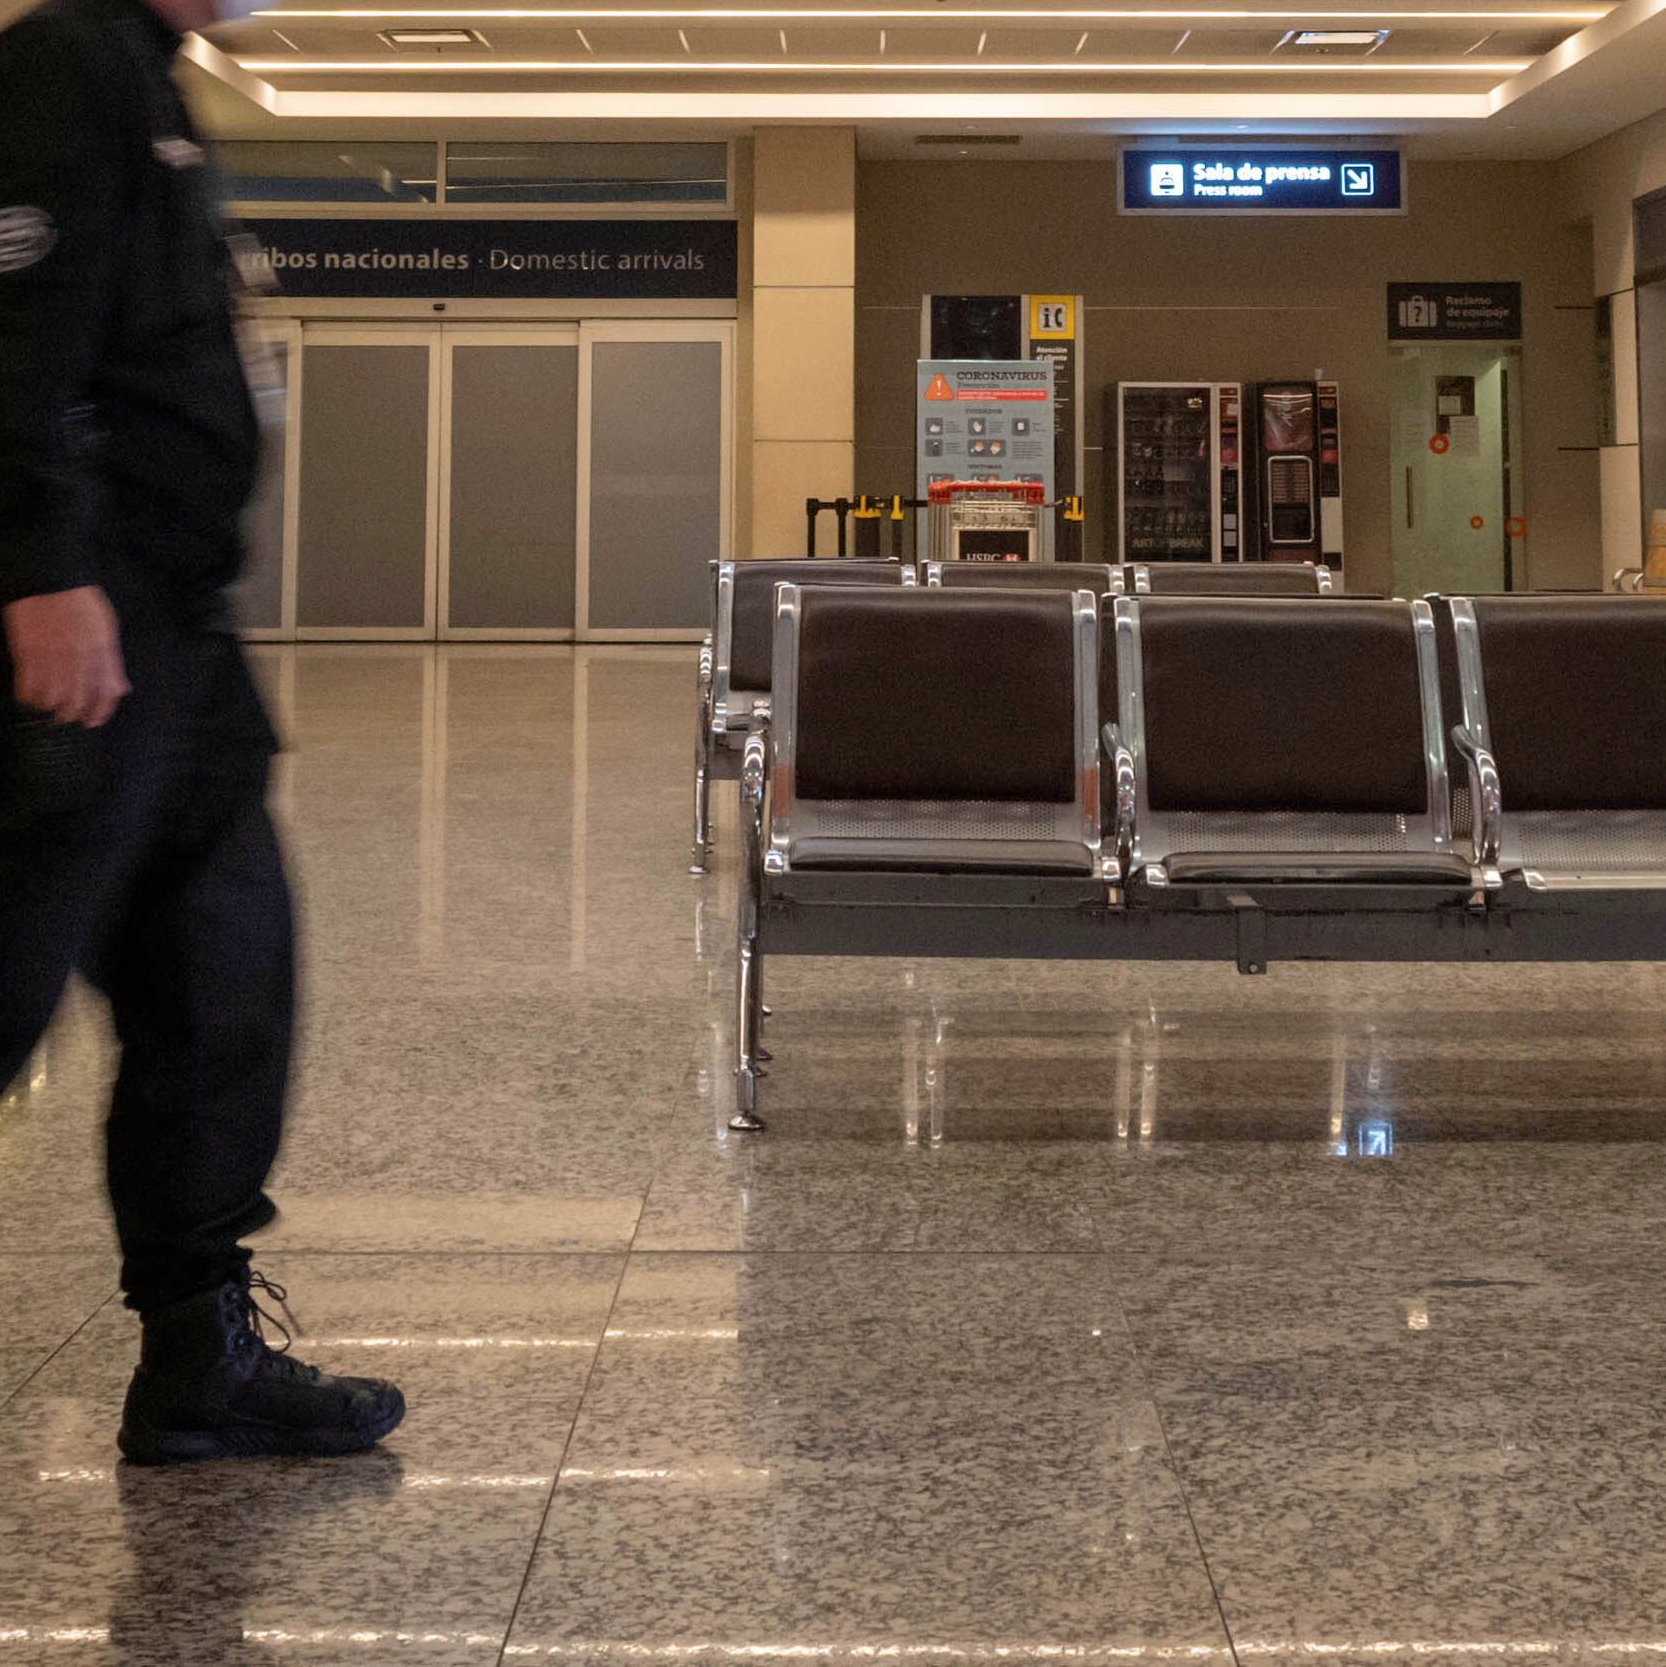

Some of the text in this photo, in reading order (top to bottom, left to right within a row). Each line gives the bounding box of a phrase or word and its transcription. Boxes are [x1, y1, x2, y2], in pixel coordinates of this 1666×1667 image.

[1193, 163, 1331, 185] Sala de prensa
[1194, 184, 1263, 196] Press room
[243, 247, 705, 271] ribos nacionales Domestic arrivals
[956, 371, 1048, 381] CORONAVIRUS
